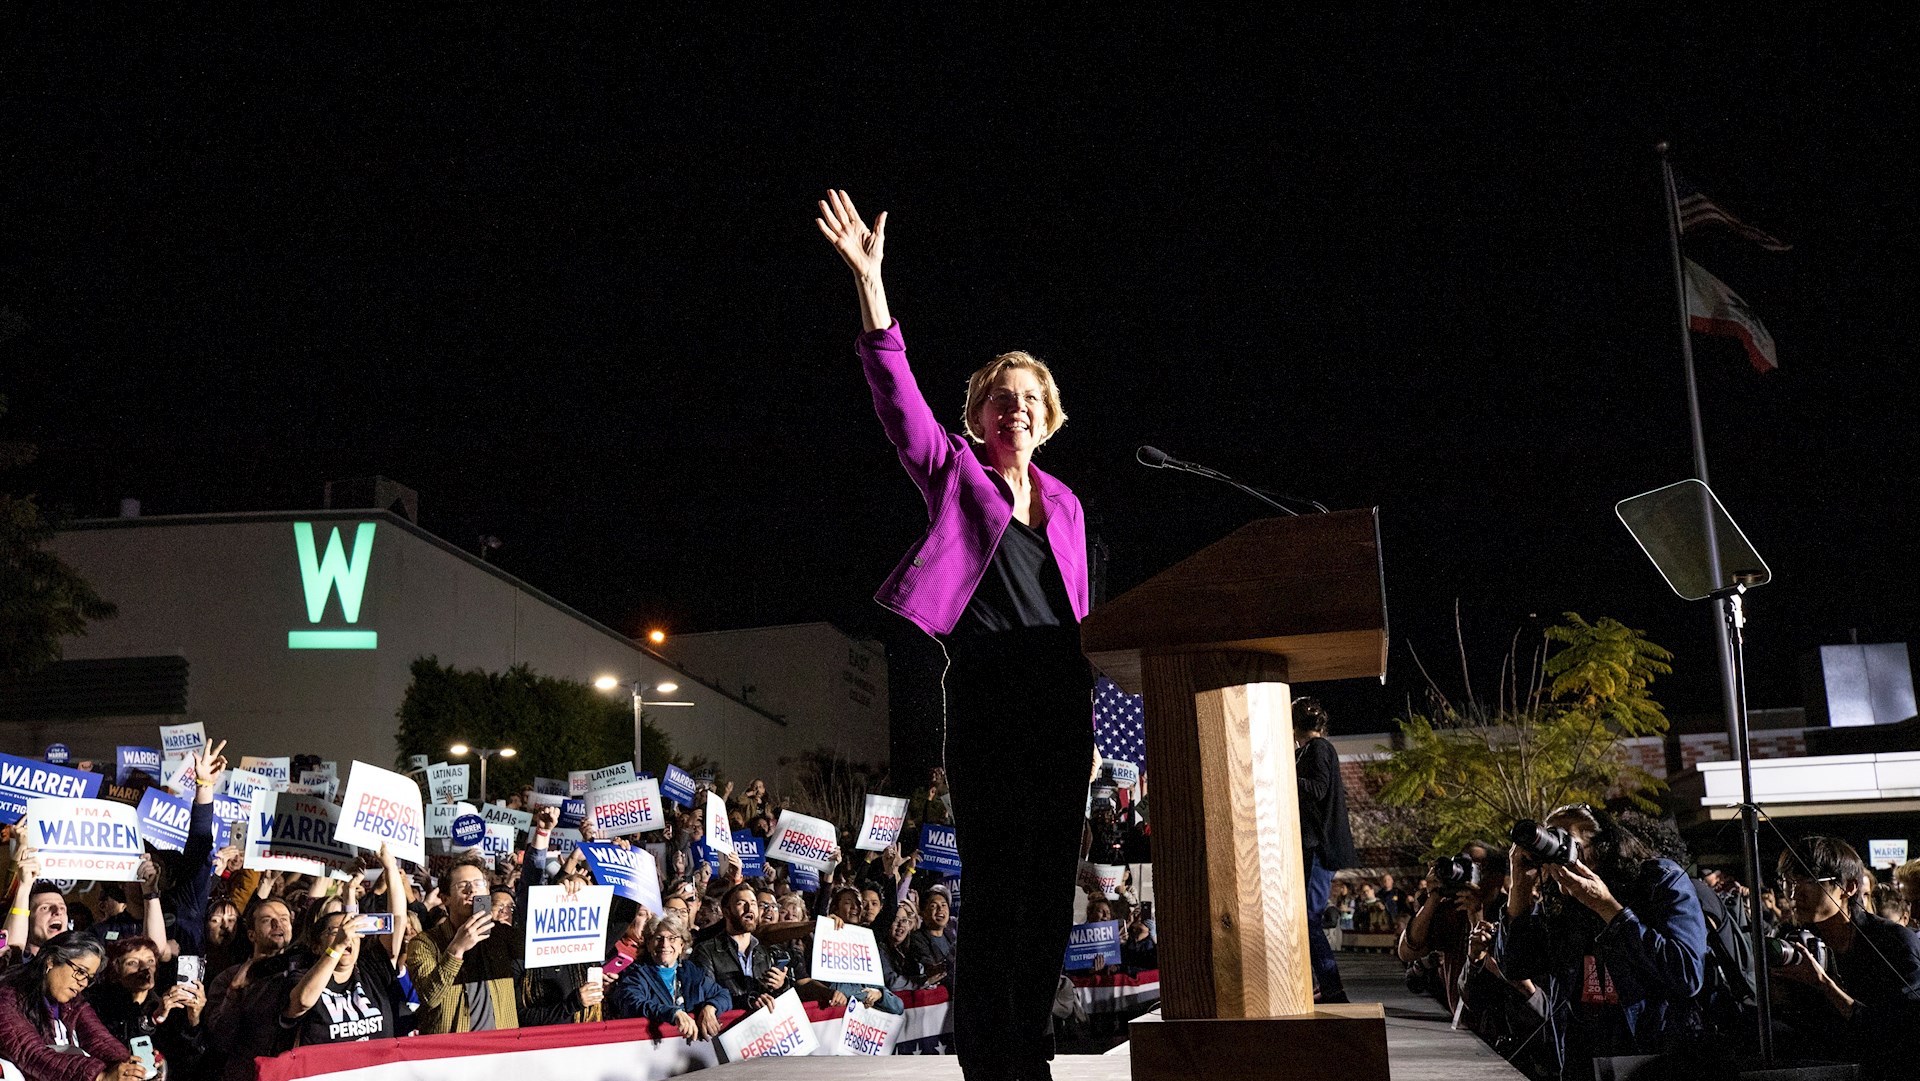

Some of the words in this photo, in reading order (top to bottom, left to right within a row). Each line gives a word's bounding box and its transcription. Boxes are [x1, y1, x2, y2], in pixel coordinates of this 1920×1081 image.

[293, 521, 377, 624] W
[164, 732, 201, 748] WARREN
[123, 751, 160, 765] WARREN
[1, 762, 88, 799] WARREN
[432, 768, 463, 779] LATINAS
[591, 765, 627, 780] LATINAS
[670, 769, 696, 791] WARREN
[233, 781, 274, 799] WAR
[435, 784, 463, 797] WARREN
[12, 803, 27, 815] FIG
[75, 807, 98, 817] I'M
[102, 809, 112, 818] A
[295, 802, 317, 814] I'M
[319, 808, 328, 817] A
[358, 793, 419, 832] PERSISTE
[594, 797, 651, 818] PERSISTE
[485, 808, 517, 826] AAPIs
[596, 808, 652, 829] PERSISTE
[38, 820, 139, 849] WARREN
[260, 812, 350, 850] WARRE
[353, 810, 419, 847] PERSISTE
[456, 823, 482, 835] WARREN
[779, 839, 831, 862] PERSISTE
[783, 829, 833, 855] PERSISTE
[262, 849, 346, 870] DEMOCRAT
[936, 855, 952, 864] FIGHT
[1873, 847, 1905, 856] WARREN
[45, 858, 135, 871] DEMOCRAT
[603, 875, 621, 885] TEXT
[556, 894, 570, 903] I'M
[571, 893, 579, 902] A
[534, 906, 601, 934] WARREN
[1069, 926, 1114, 944] WARREN
[536, 943, 594, 956] DEMOCRAT
[821, 939, 872, 961] PERSISTE
[820, 953, 873, 972] PERSISTE
[1588, 985, 1614, 993] 200
[329, 1016, 383, 1040] PERSIST
[848, 1018, 887, 1047] PERSISTE
[740, 1016, 796, 1060] PERSISTE
[844, 1031, 881, 1056] PERSISTE
